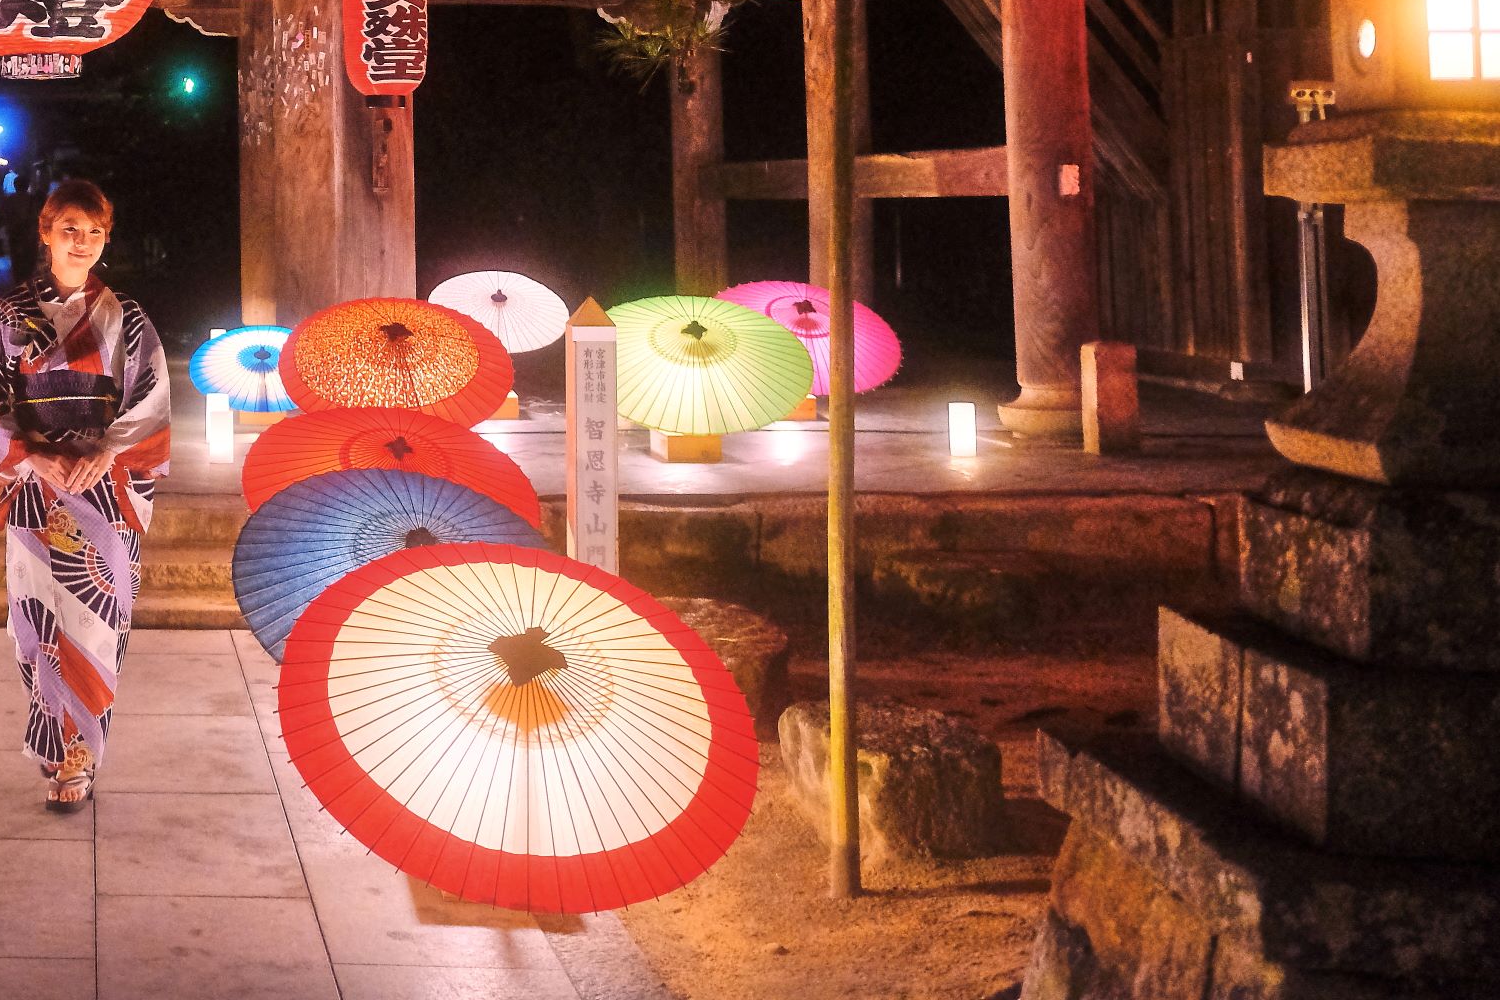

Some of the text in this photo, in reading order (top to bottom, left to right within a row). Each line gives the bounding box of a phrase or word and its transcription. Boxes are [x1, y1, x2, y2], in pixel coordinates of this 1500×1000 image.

[583, 347, 595, 404] 有形文化財
[595, 346, 607, 405] 宮津市指定
[584, 416, 608, 567] 智恩寺山門
